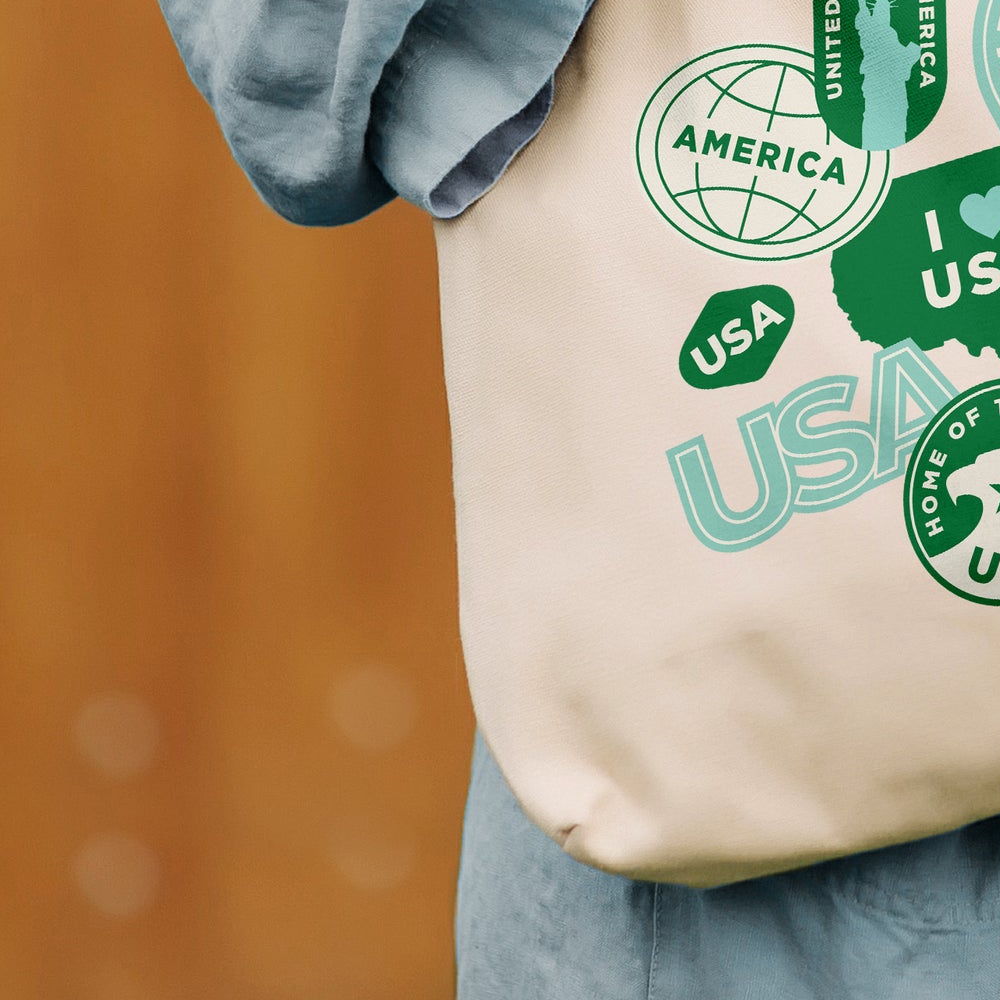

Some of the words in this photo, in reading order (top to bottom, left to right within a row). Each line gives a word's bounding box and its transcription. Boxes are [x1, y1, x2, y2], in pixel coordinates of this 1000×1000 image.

[672, 124, 846, 186] AMERICA
[924, 209, 943, 253] I
[689, 299, 786, 376] USA
[665, 337, 961, 553] USA
[921, 449, 948, 537] HOME
[948, 406, 981, 440] OF
